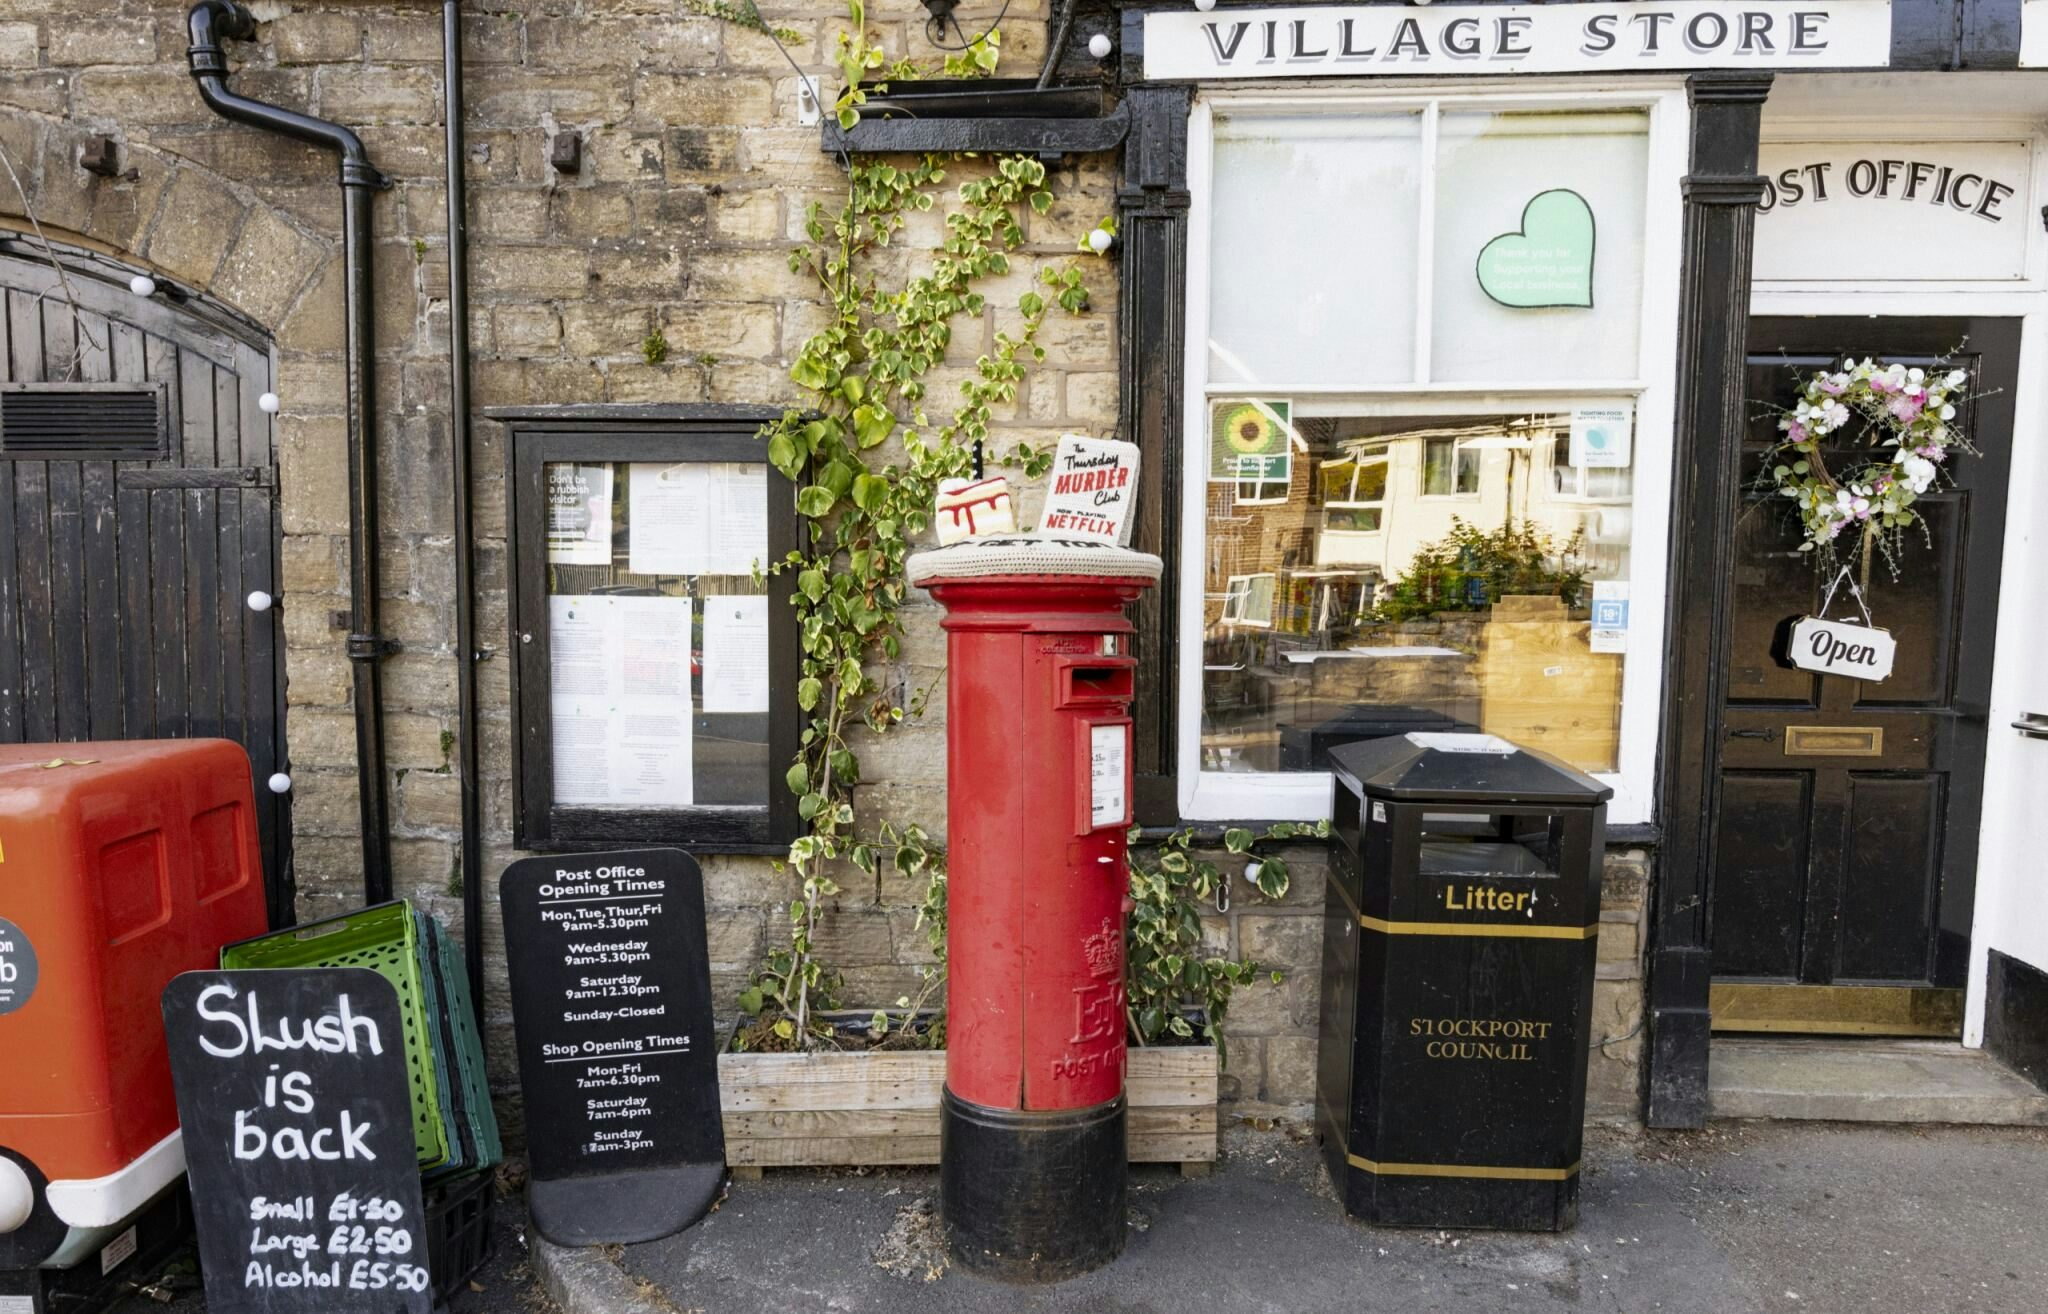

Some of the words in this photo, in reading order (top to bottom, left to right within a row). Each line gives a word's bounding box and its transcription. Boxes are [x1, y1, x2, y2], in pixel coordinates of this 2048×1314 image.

[1201, 16, 1533, 66] VILLAGE
[1580, 11, 1830, 57] STORE
[1756, 162, 1832, 215] OST
[1846, 159, 2015, 224] OFFICE
[1073, 443, 1086, 453] The
[1063, 452, 1119, 470] Thursday
[549, 474, 573, 484] Don't
[575, 474, 587, 484] be
[1054, 467, 1129, 495] MURDER
[549, 486, 556, 494] a
[557, 484, 590, 494] rubbish
[1094, 490, 1121, 506] Club
[549, 494, 577, 504] visitor
[1046, 514, 1117, 537] NETFLIX
[1809, 629, 1877, 667] Open
[555, 868, 592, 881] Post
[596, 865, 645, 879] Office
[538, 882, 610, 899] Opening
[613, 879, 665, 892] Times
[1445, 885, 1530, 911] Litter
[541, 903, 662, 922] Mon,Tue,Thur,Fri
[562, 917, 649, 932] 9am-5.30pm
[568, 940, 648, 954] Wednesday
[564, 951, 650, 966] 9am-5.30pm
[580, 974, 642, 987] Saturday
[565, 984, 660, 1000] 9am-12.30pm
[563, 1004, 665, 1023] Sunday-Closed
[1410, 1017, 1552, 1039] STOCKPORT
[542, 1044, 579, 1057] Shop
[582, 1039, 643, 1054] Opening
[645, 1035, 690, 1048] Times
[1426, 1041, 1533, 1061] COUNCIL
[587, 1063, 641, 1077] Mon-Fri
[1051, 1053, 1100, 1081] POST
[264, 1064, 315, 1114] is
[576, 1074, 660, 1088] 7am-6.30pm
[587, 1096, 647, 1109] Saturday
[587, 1106, 651, 1120] 7am-6pm
[234, 1110, 377, 1161] back
[594, 1129, 643, 1141] Sunday
[250, 1196, 314, 1222] Small
[250, 1226, 320, 1259] Large
[245, 1260, 340, 1288] Alcohol
